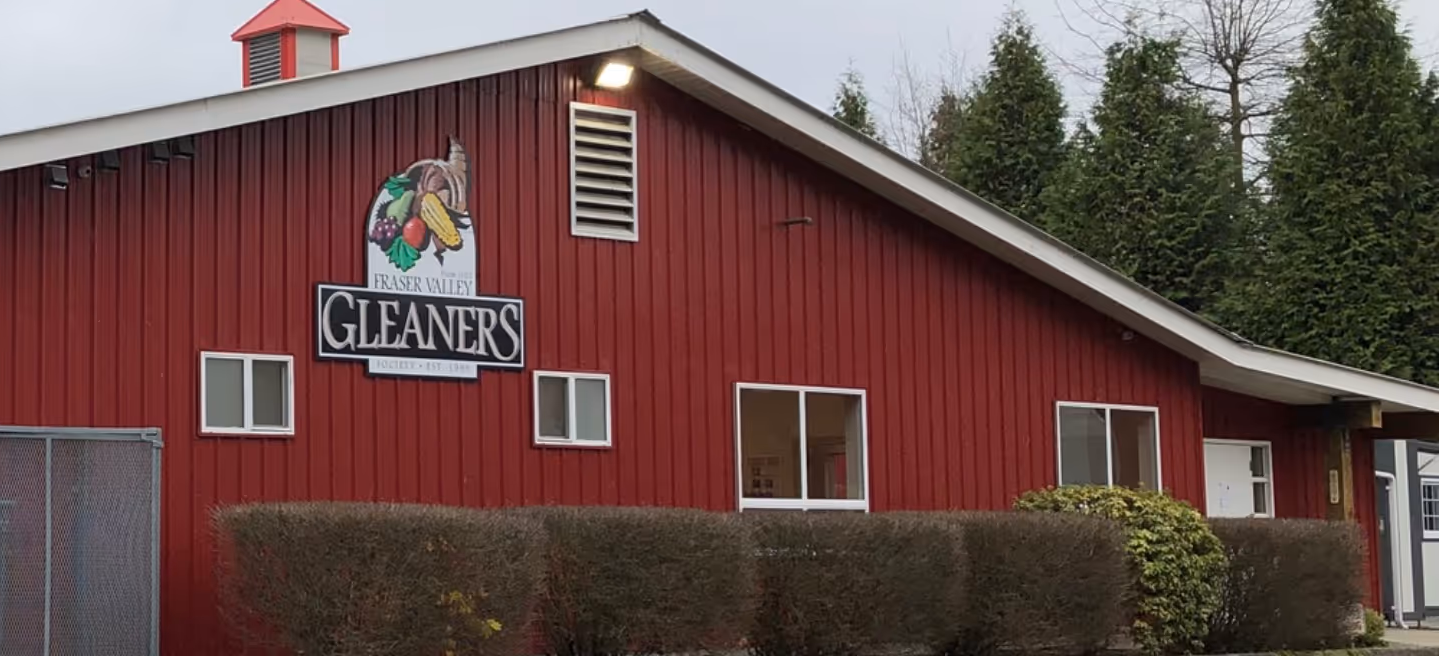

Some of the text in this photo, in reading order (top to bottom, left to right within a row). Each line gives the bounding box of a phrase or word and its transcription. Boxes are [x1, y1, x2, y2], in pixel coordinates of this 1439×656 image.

[375, 273, 422, 293] FRASER
[425, 276, 473, 296] VALLEY
[322, 291, 520, 361] GLEANERS
